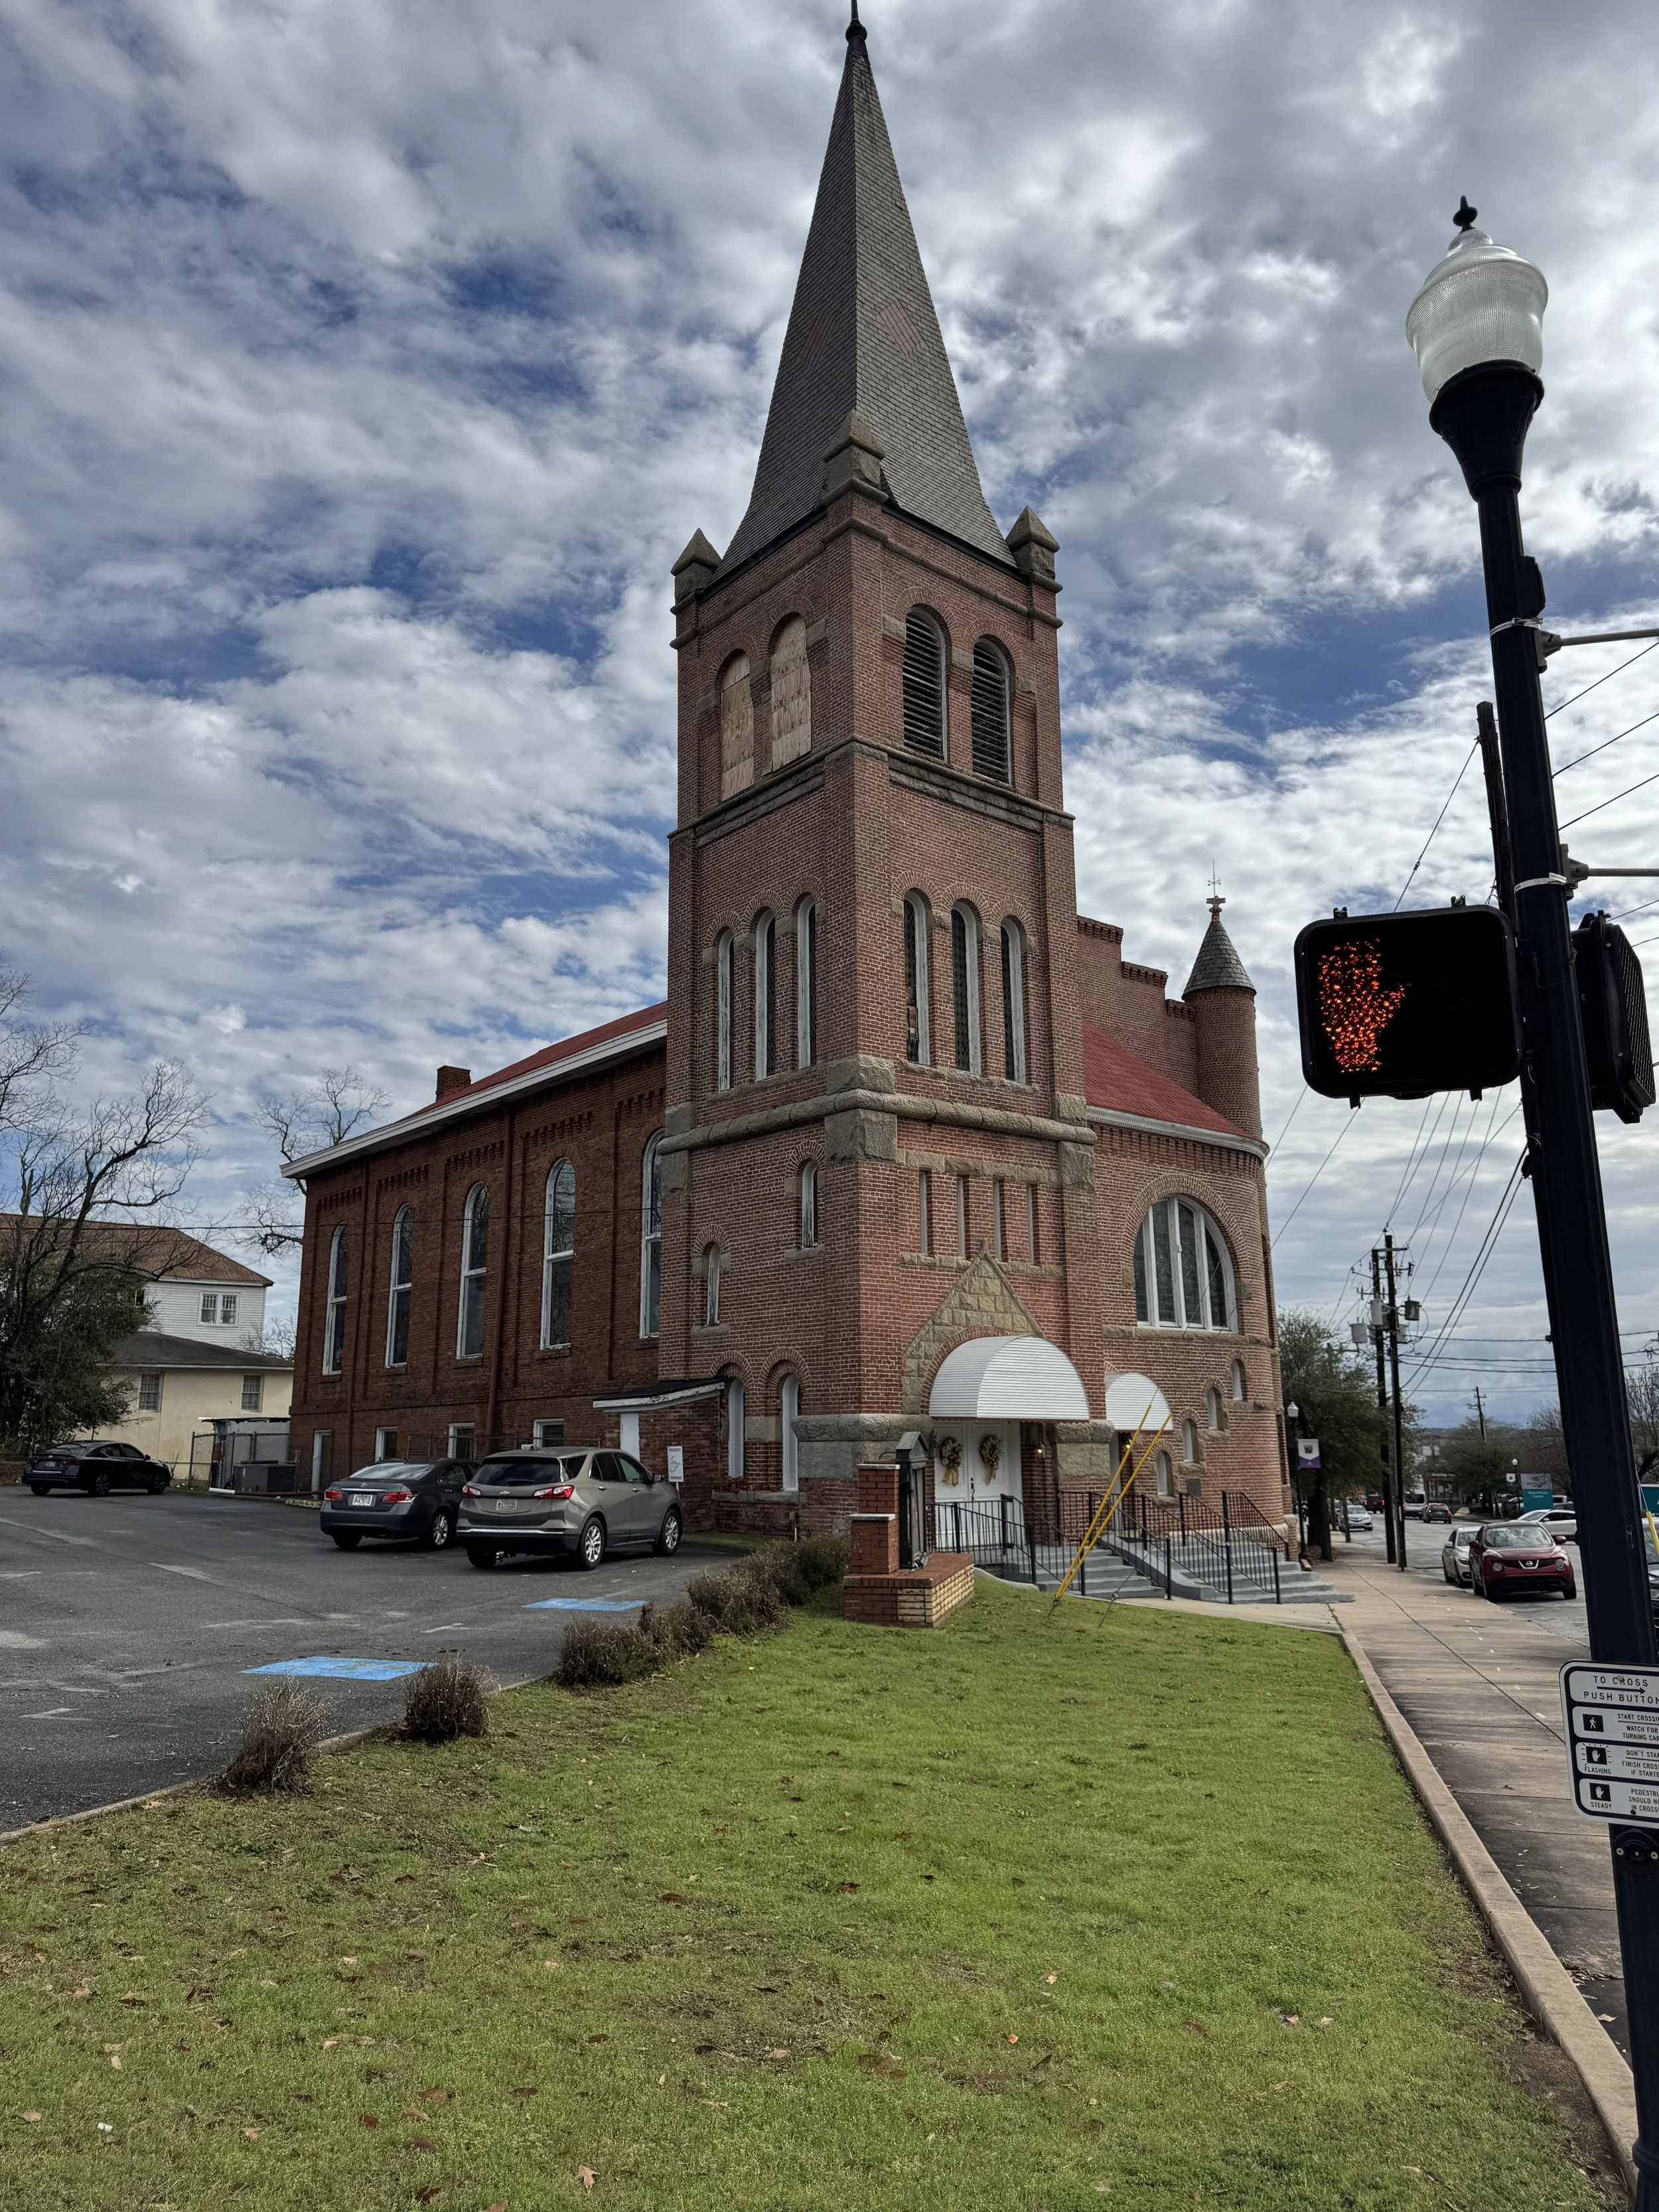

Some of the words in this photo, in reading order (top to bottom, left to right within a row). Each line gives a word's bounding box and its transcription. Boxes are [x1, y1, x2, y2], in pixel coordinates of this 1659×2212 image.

[1593, 1675, 1606, 1684] TO
[1613, 1676, 1648, 1687] CROSS
[1583, 1691, 1613, 1701] PUSH
[1584, 1766, 1612, 1775] FLASHING
[1630, 1788, 1659, 1797] PEDESTRI
[1639, 1805, 1659, 1813] CROSS
